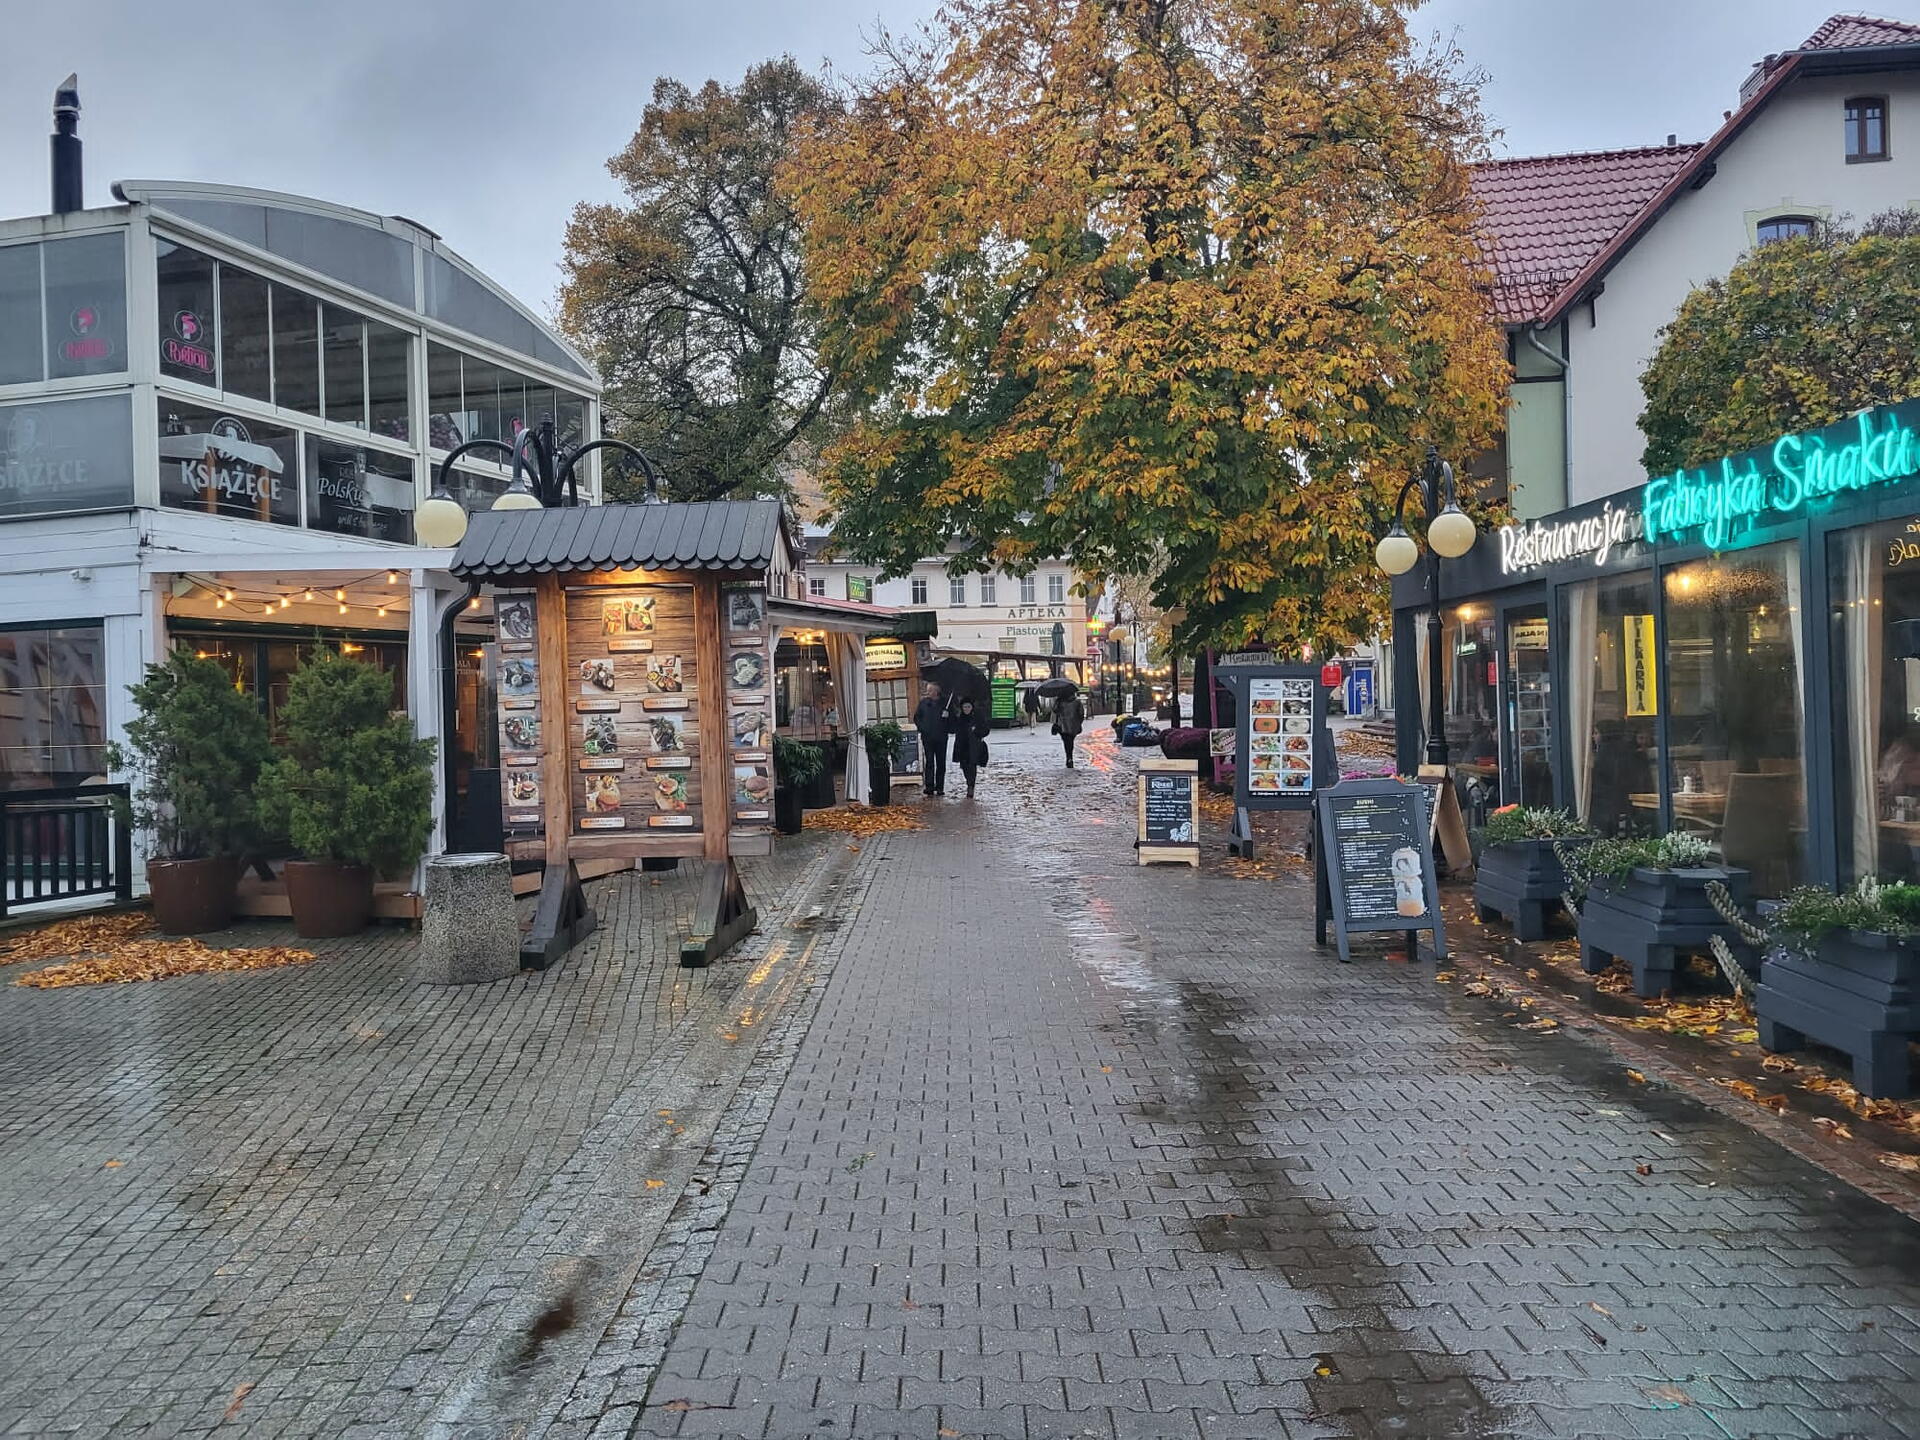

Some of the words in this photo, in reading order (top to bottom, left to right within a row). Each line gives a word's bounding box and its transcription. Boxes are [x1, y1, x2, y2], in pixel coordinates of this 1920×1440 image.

[181, 460, 282, 503] KSIĄŻĘCE
[1500, 501, 1626, 574] Restauracja
[1643, 456, 1763, 549] Fabryka
[1773, 412, 1912, 511] Smaku
[1006, 626, 1053, 636] Piastows
[1008, 607, 1066, 618] APTEKA
[1633, 617, 1645, 712] PIEKARNIA
